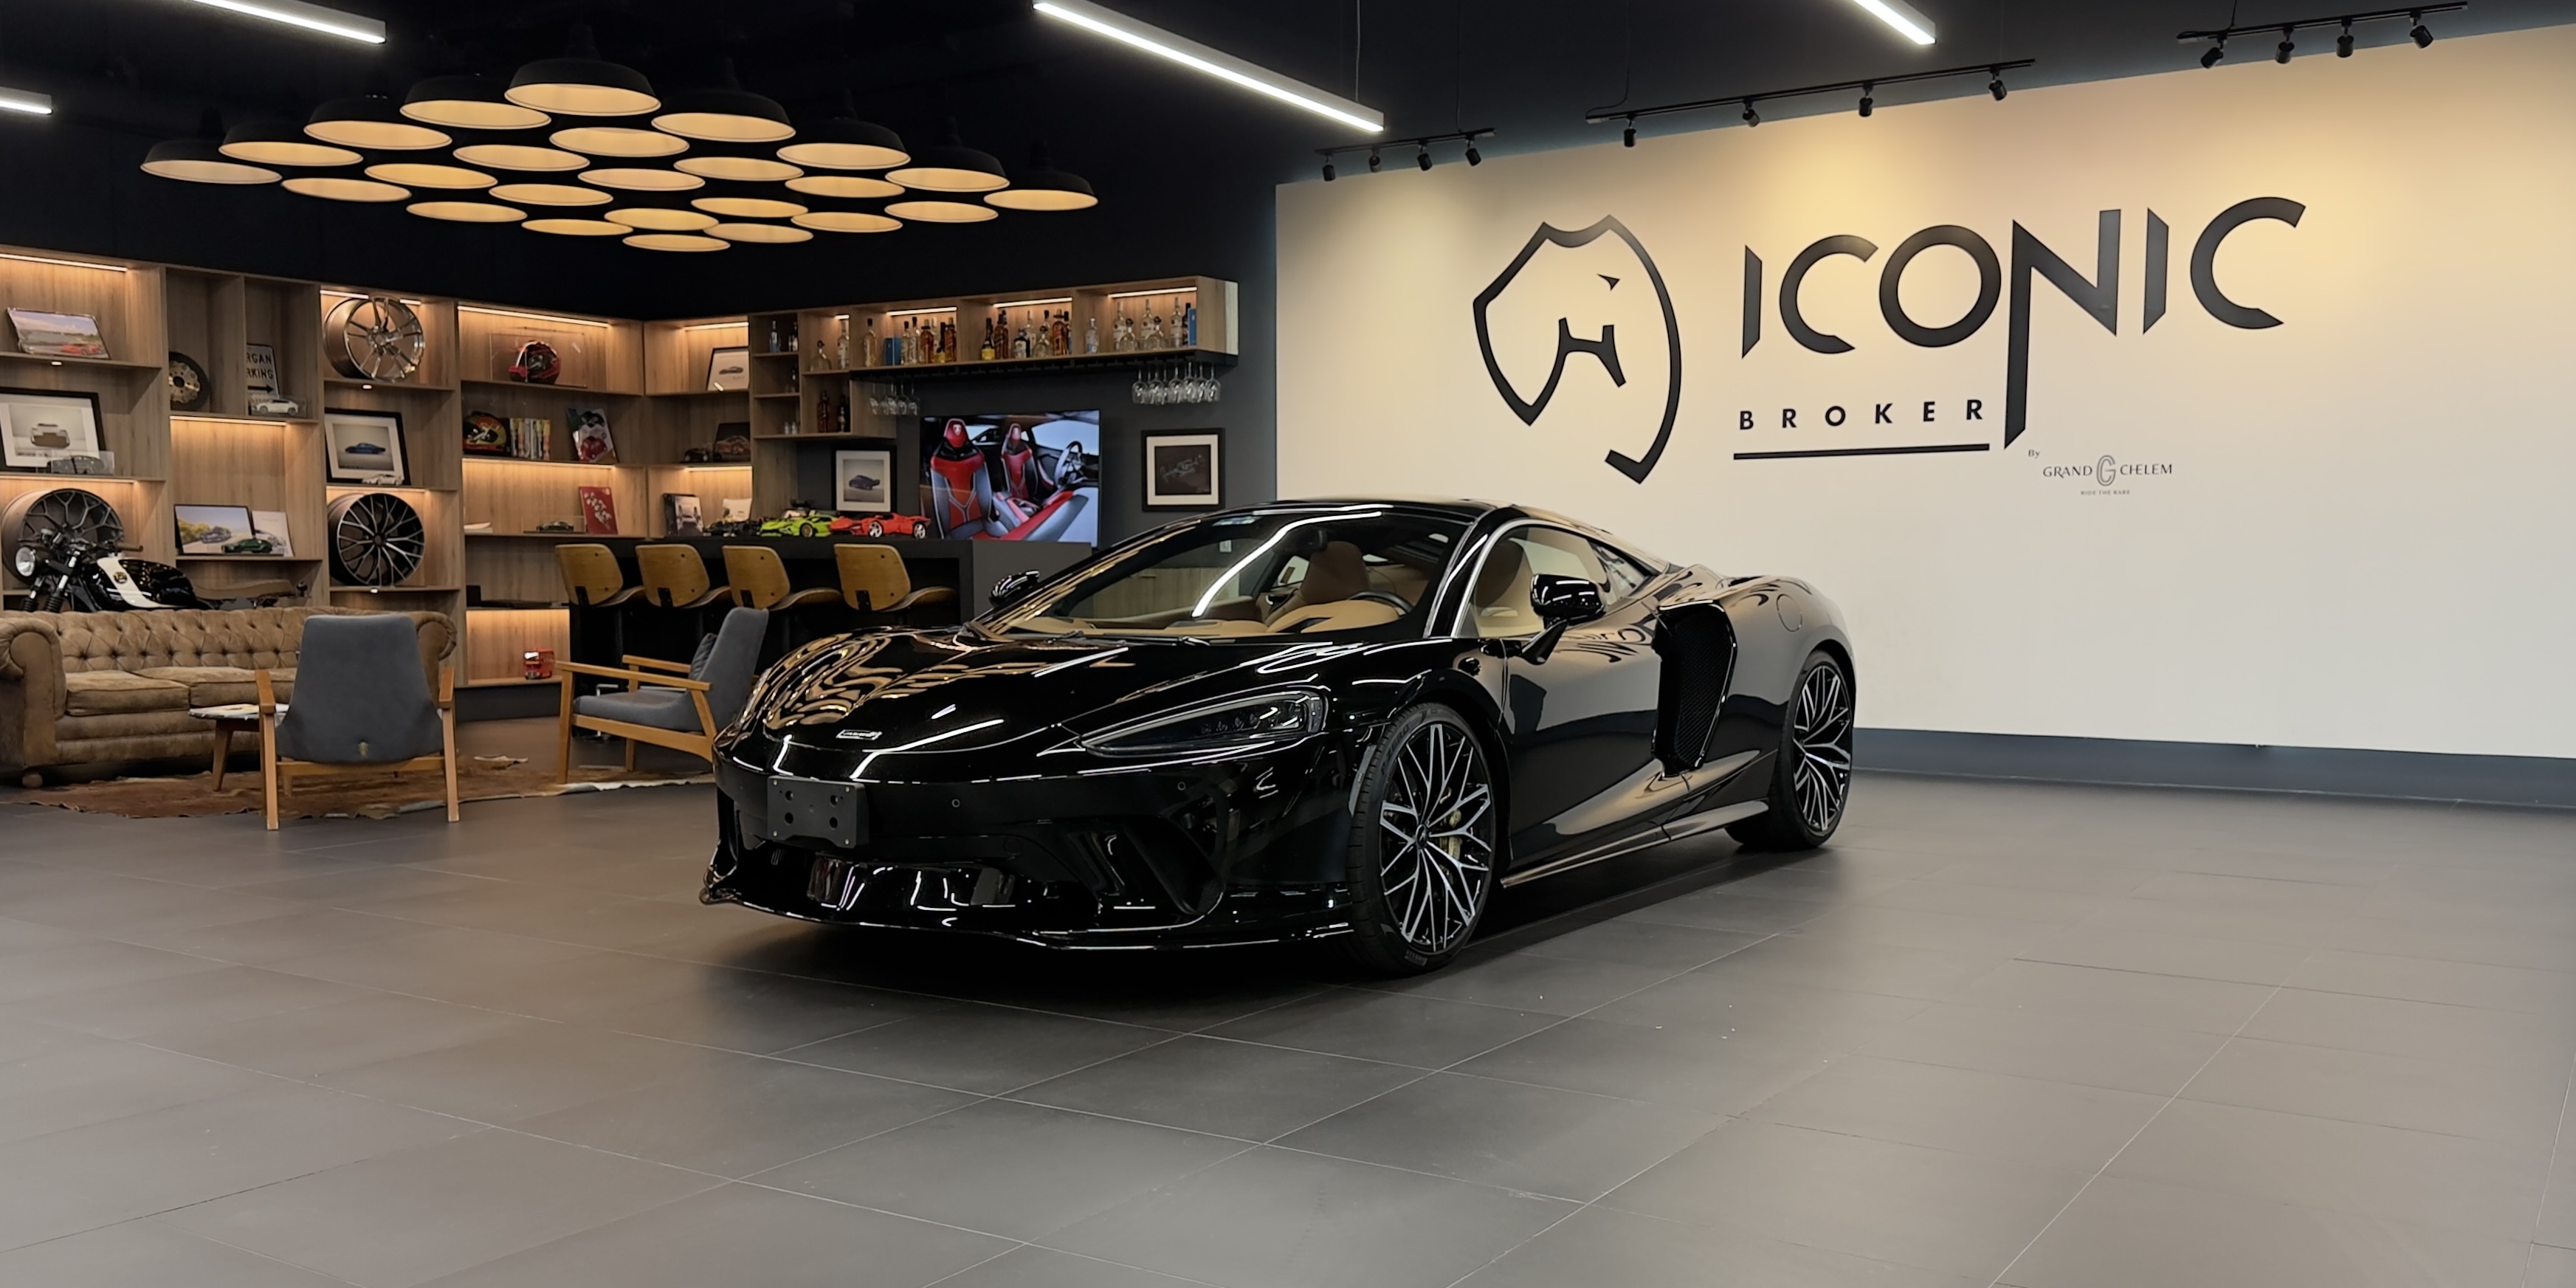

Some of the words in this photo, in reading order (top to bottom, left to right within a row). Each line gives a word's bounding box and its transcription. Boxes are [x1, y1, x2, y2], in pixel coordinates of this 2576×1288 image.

[1742, 197, 2307, 449] ICONIC
[1740, 399, 1983, 430] BROKER
[2028, 449, 2040, 458] By
[2042, 465, 2093, 478] GRAND
[2119, 463, 2173, 476] CHELEM
